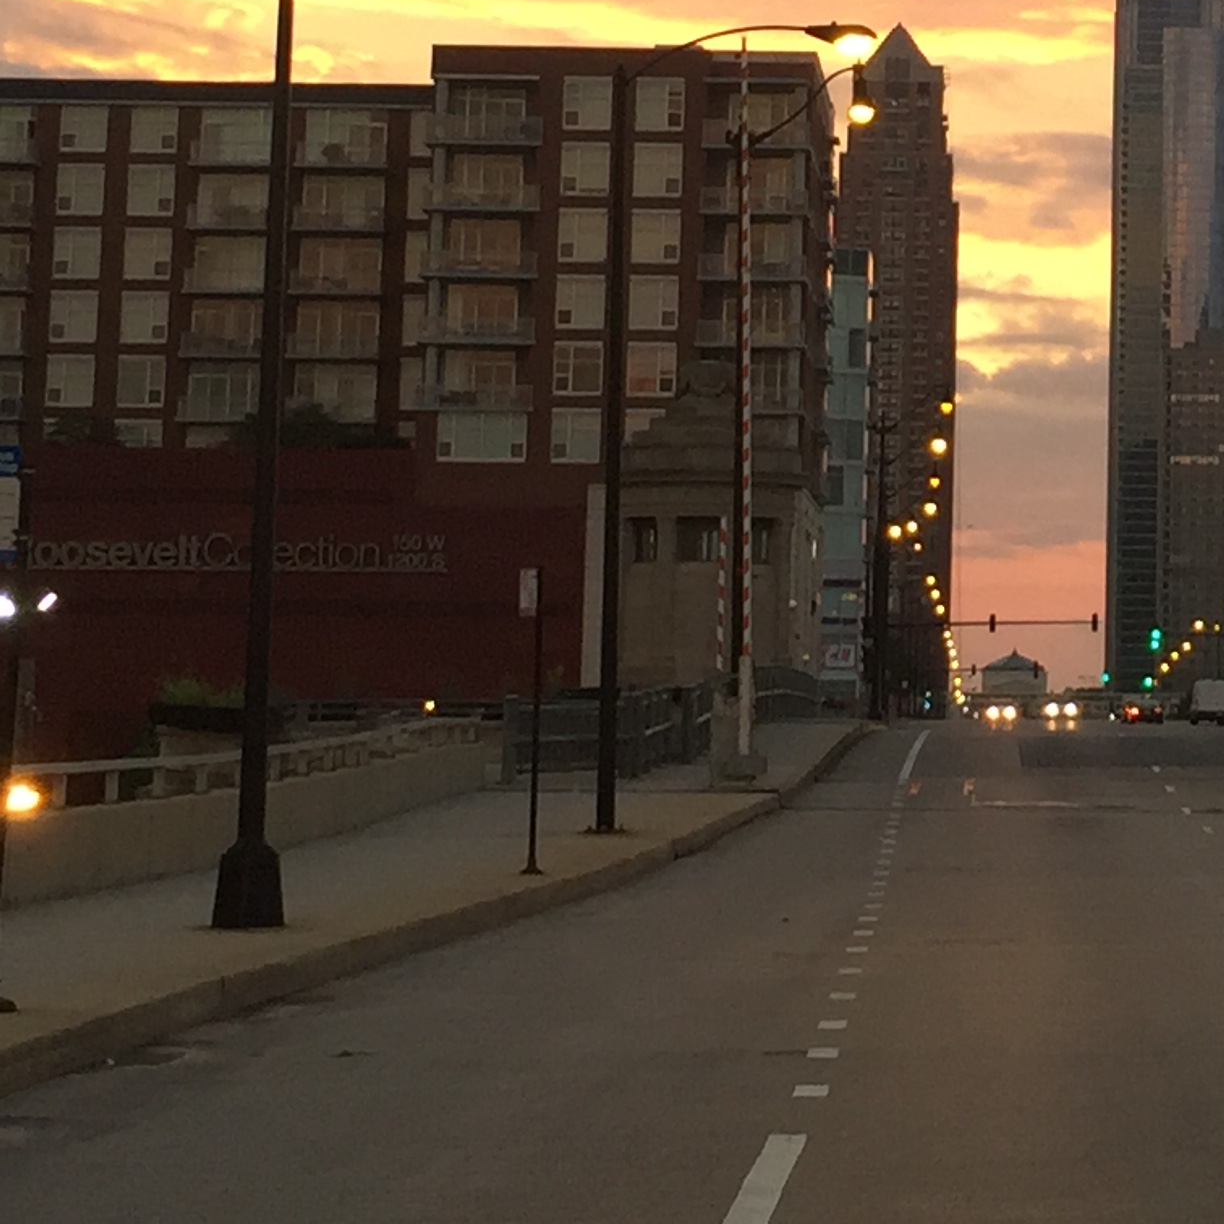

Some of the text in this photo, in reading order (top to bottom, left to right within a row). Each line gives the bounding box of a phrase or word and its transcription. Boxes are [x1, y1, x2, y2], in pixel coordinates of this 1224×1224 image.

[27, 532, 380, 568] oosevelt Coection
[426, 534, 446, 551] W
